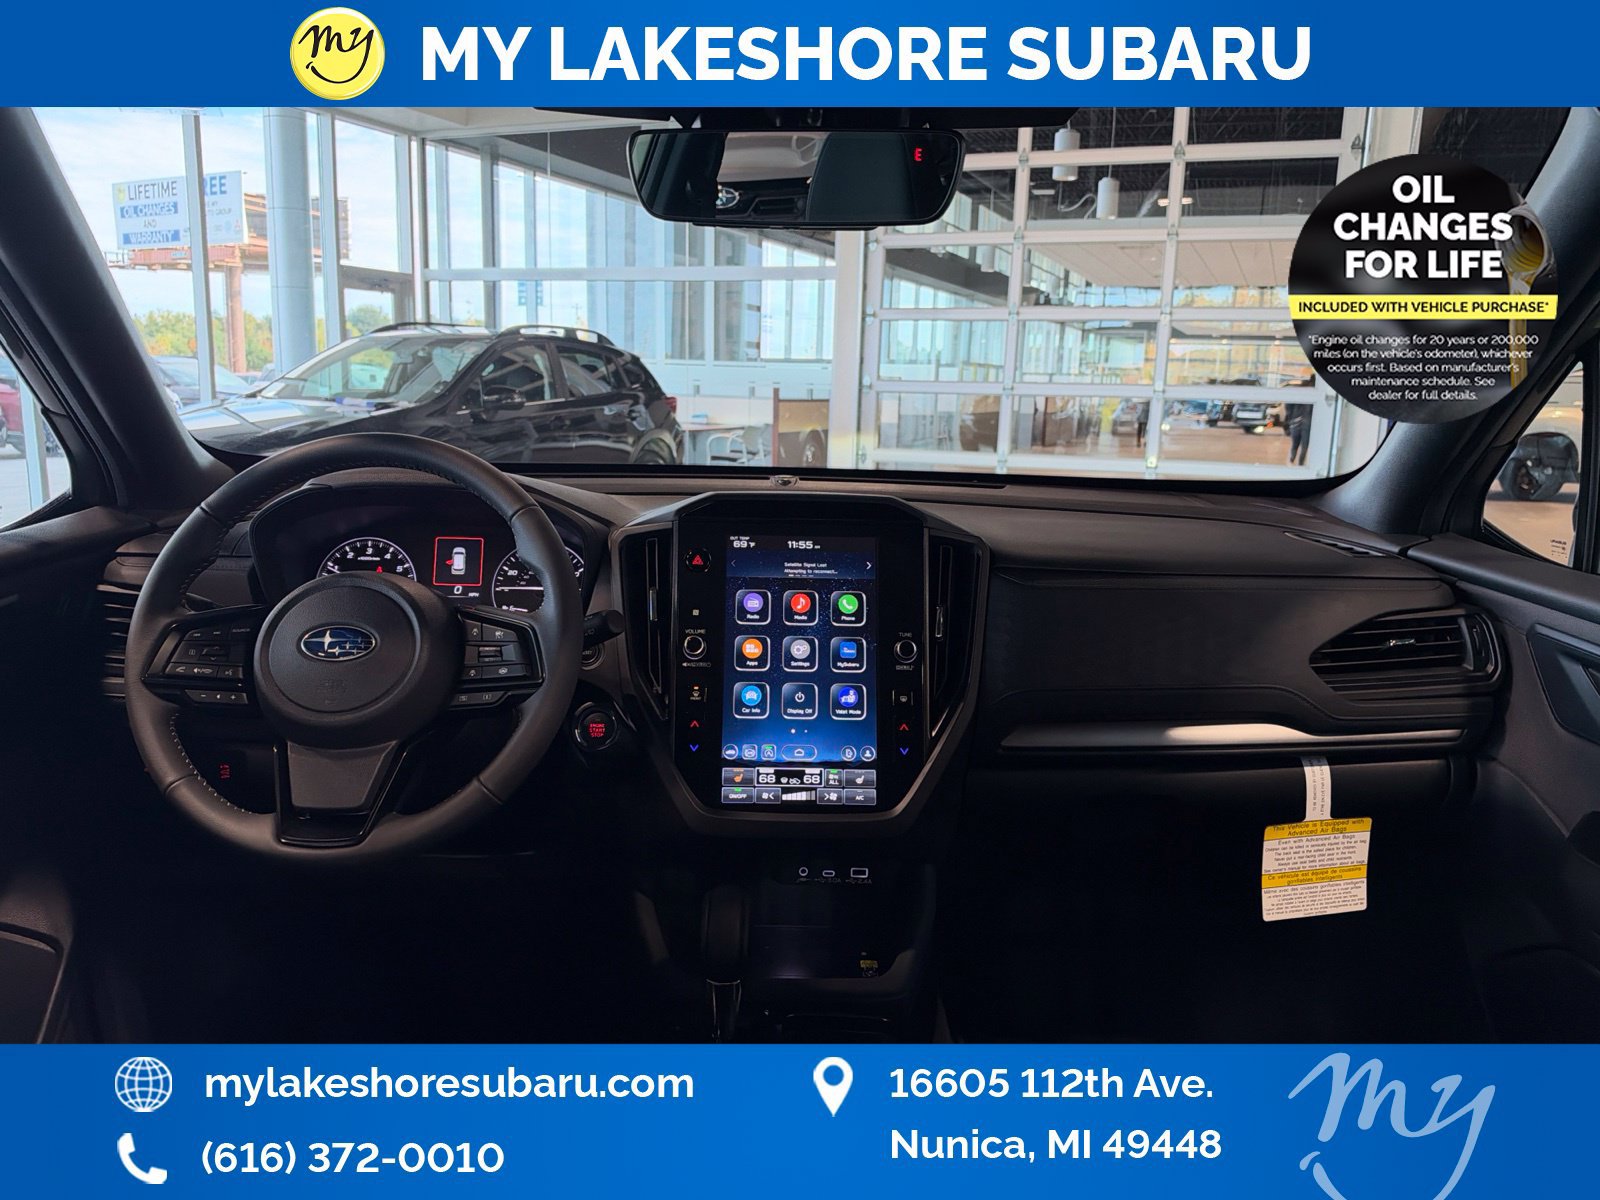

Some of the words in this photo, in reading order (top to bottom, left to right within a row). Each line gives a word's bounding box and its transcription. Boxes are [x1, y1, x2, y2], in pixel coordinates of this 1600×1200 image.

[127, 181, 178, 201] LIFETIME
[787, 540, 813, 549] 11:55
[366, 547, 373, 555] 3
[384, 552, 391, 560] 4
[507, 569, 518, 577] 20
[453, 585, 462, 595] 0
[758, 774, 776, 783] 68
[803, 775, 820, 784] 68
[1332, 826, 1347, 834] Bags
